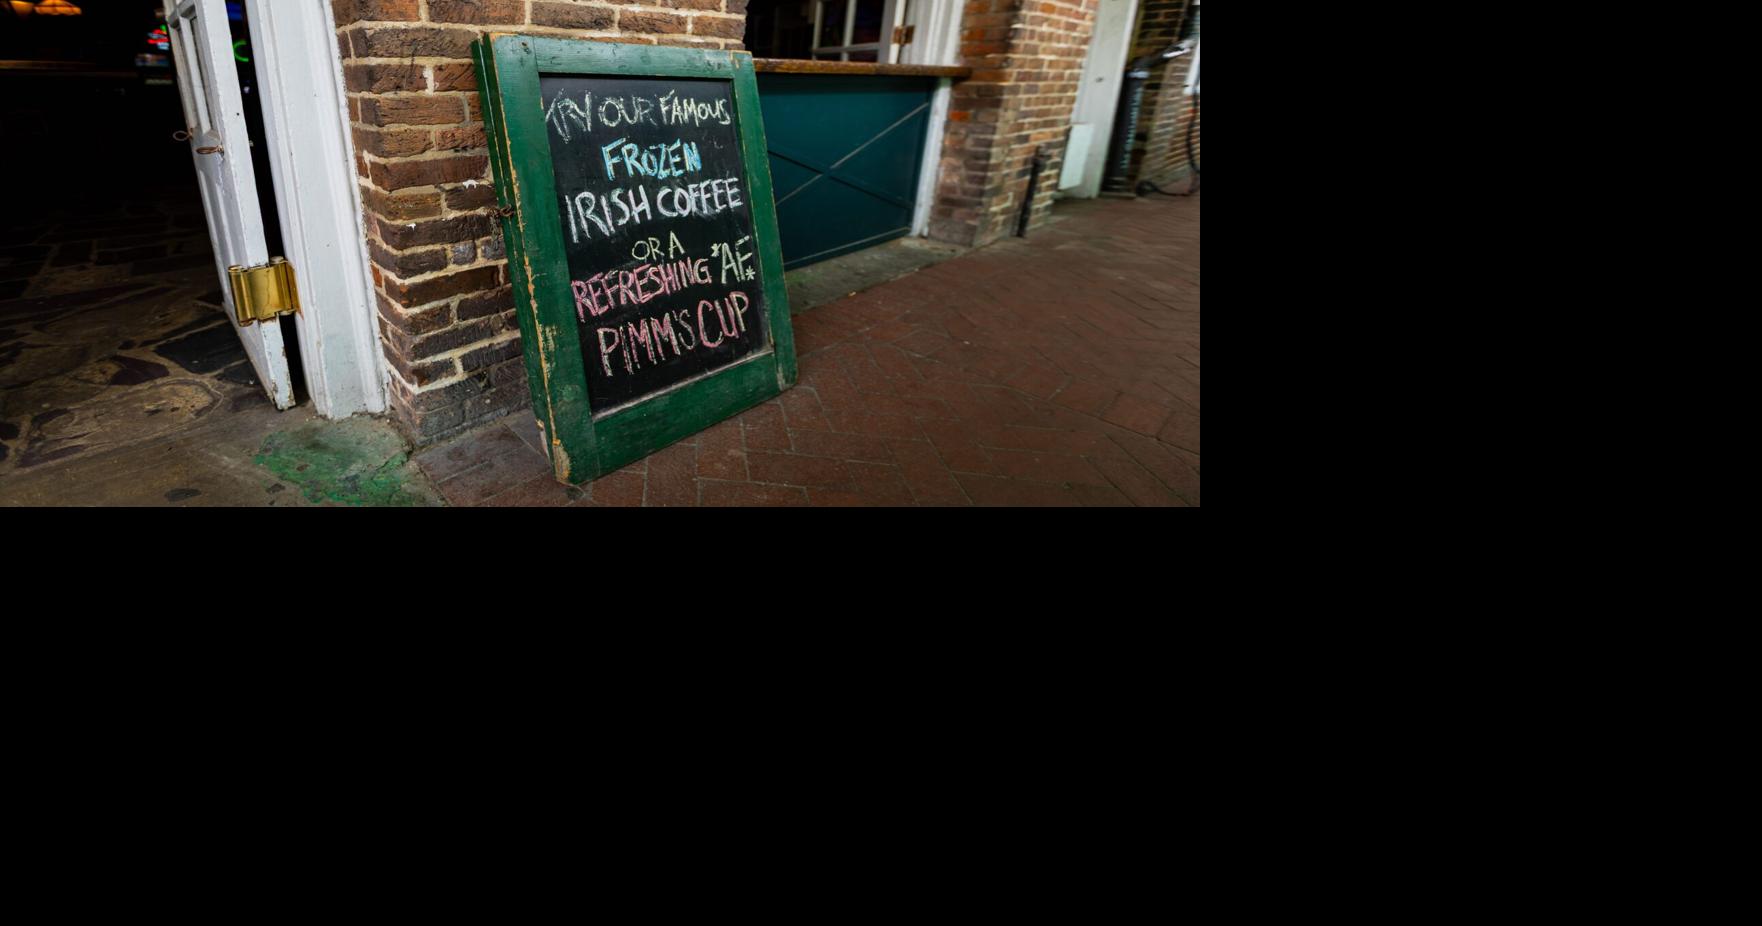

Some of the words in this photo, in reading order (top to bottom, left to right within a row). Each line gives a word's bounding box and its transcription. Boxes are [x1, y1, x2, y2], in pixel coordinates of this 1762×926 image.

[545, 88, 592, 144] TRY
[598, 96, 657, 127] OUR
[659, 89, 731, 127] FAMOUS
[601, 137, 701, 181] FROZEN
[564, 184, 652, 243] IRISH
[656, 177, 744, 217] COFFEE
[631, 237, 665, 261] OR
[669, 230, 686, 260] A
[571, 256, 712, 323] REFRESHING
[596, 309, 697, 377] PIMM'S
[697, 291, 750, 348] CUP
